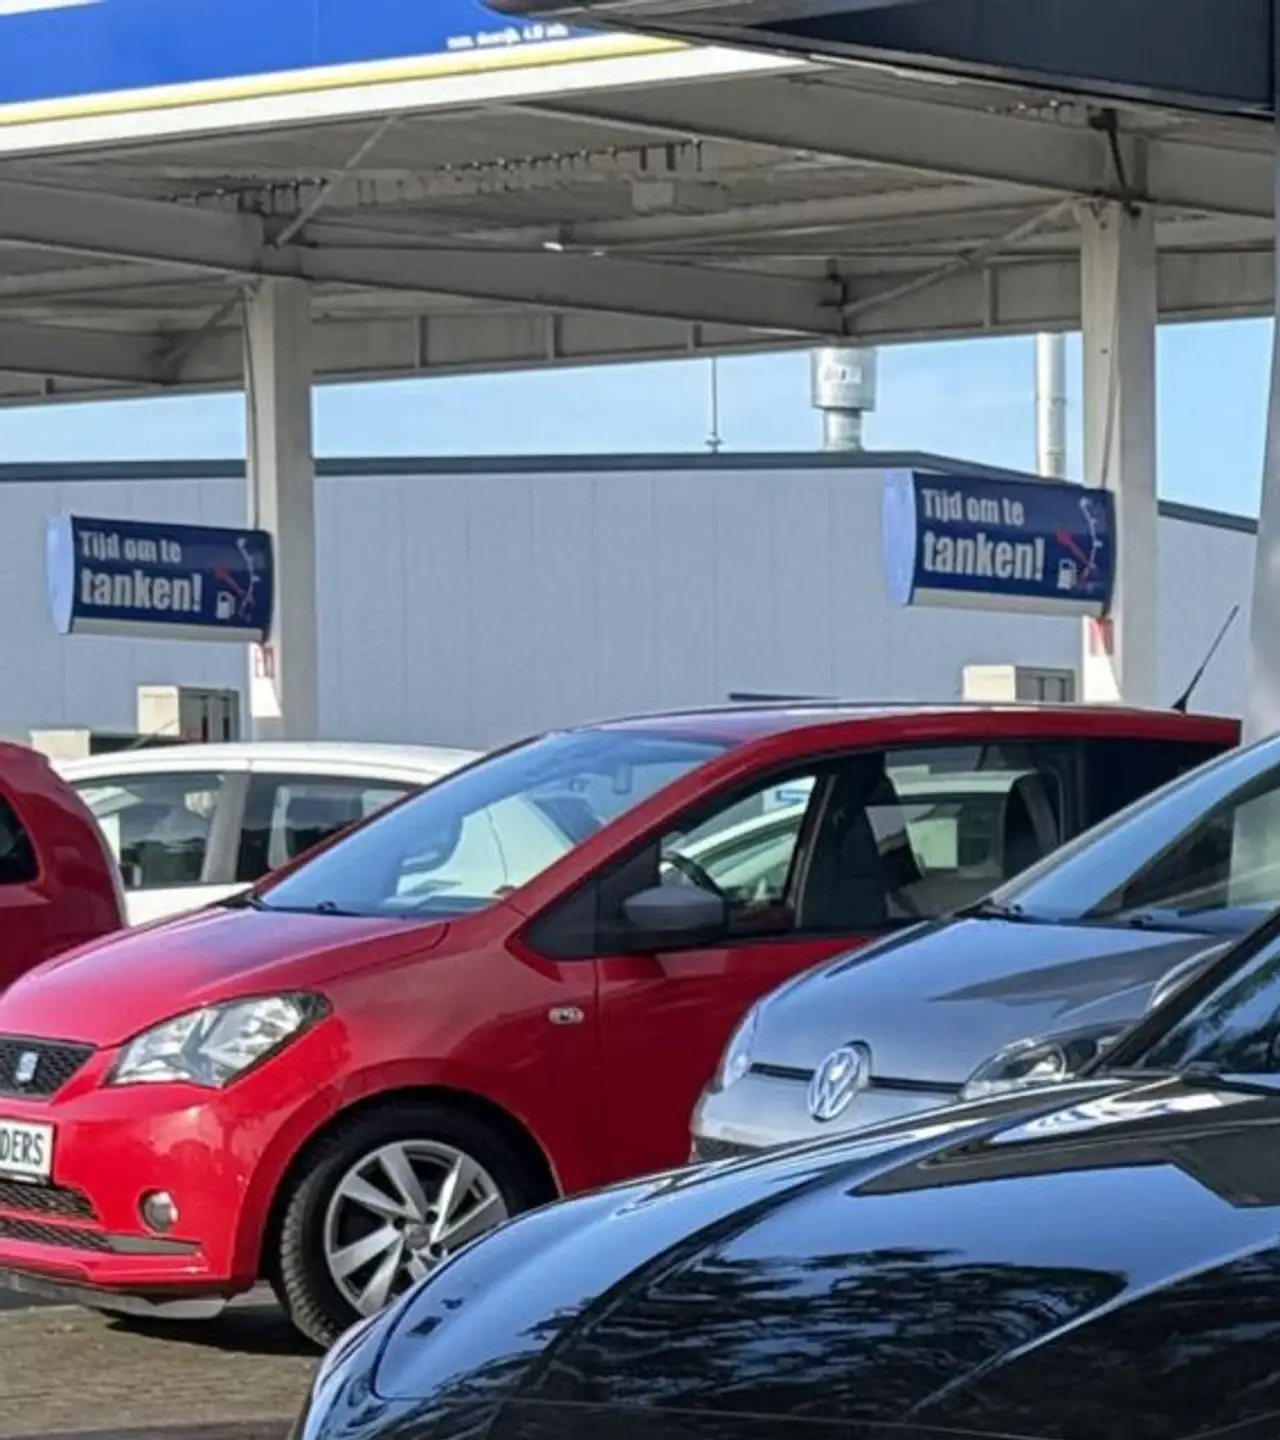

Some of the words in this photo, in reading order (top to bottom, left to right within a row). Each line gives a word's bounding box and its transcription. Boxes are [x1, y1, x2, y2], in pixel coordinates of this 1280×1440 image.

[922, 488, 962, 522] Tijd
[967, 497, 999, 525] om
[1002, 496, 1025, 526] te
[79, 531, 120, 561] Tijd
[125, 539, 157, 563] om
[159, 538, 182, 564] te
[922, 530, 1045, 582] tanken!
[80, 566, 203, 612] tanken!
